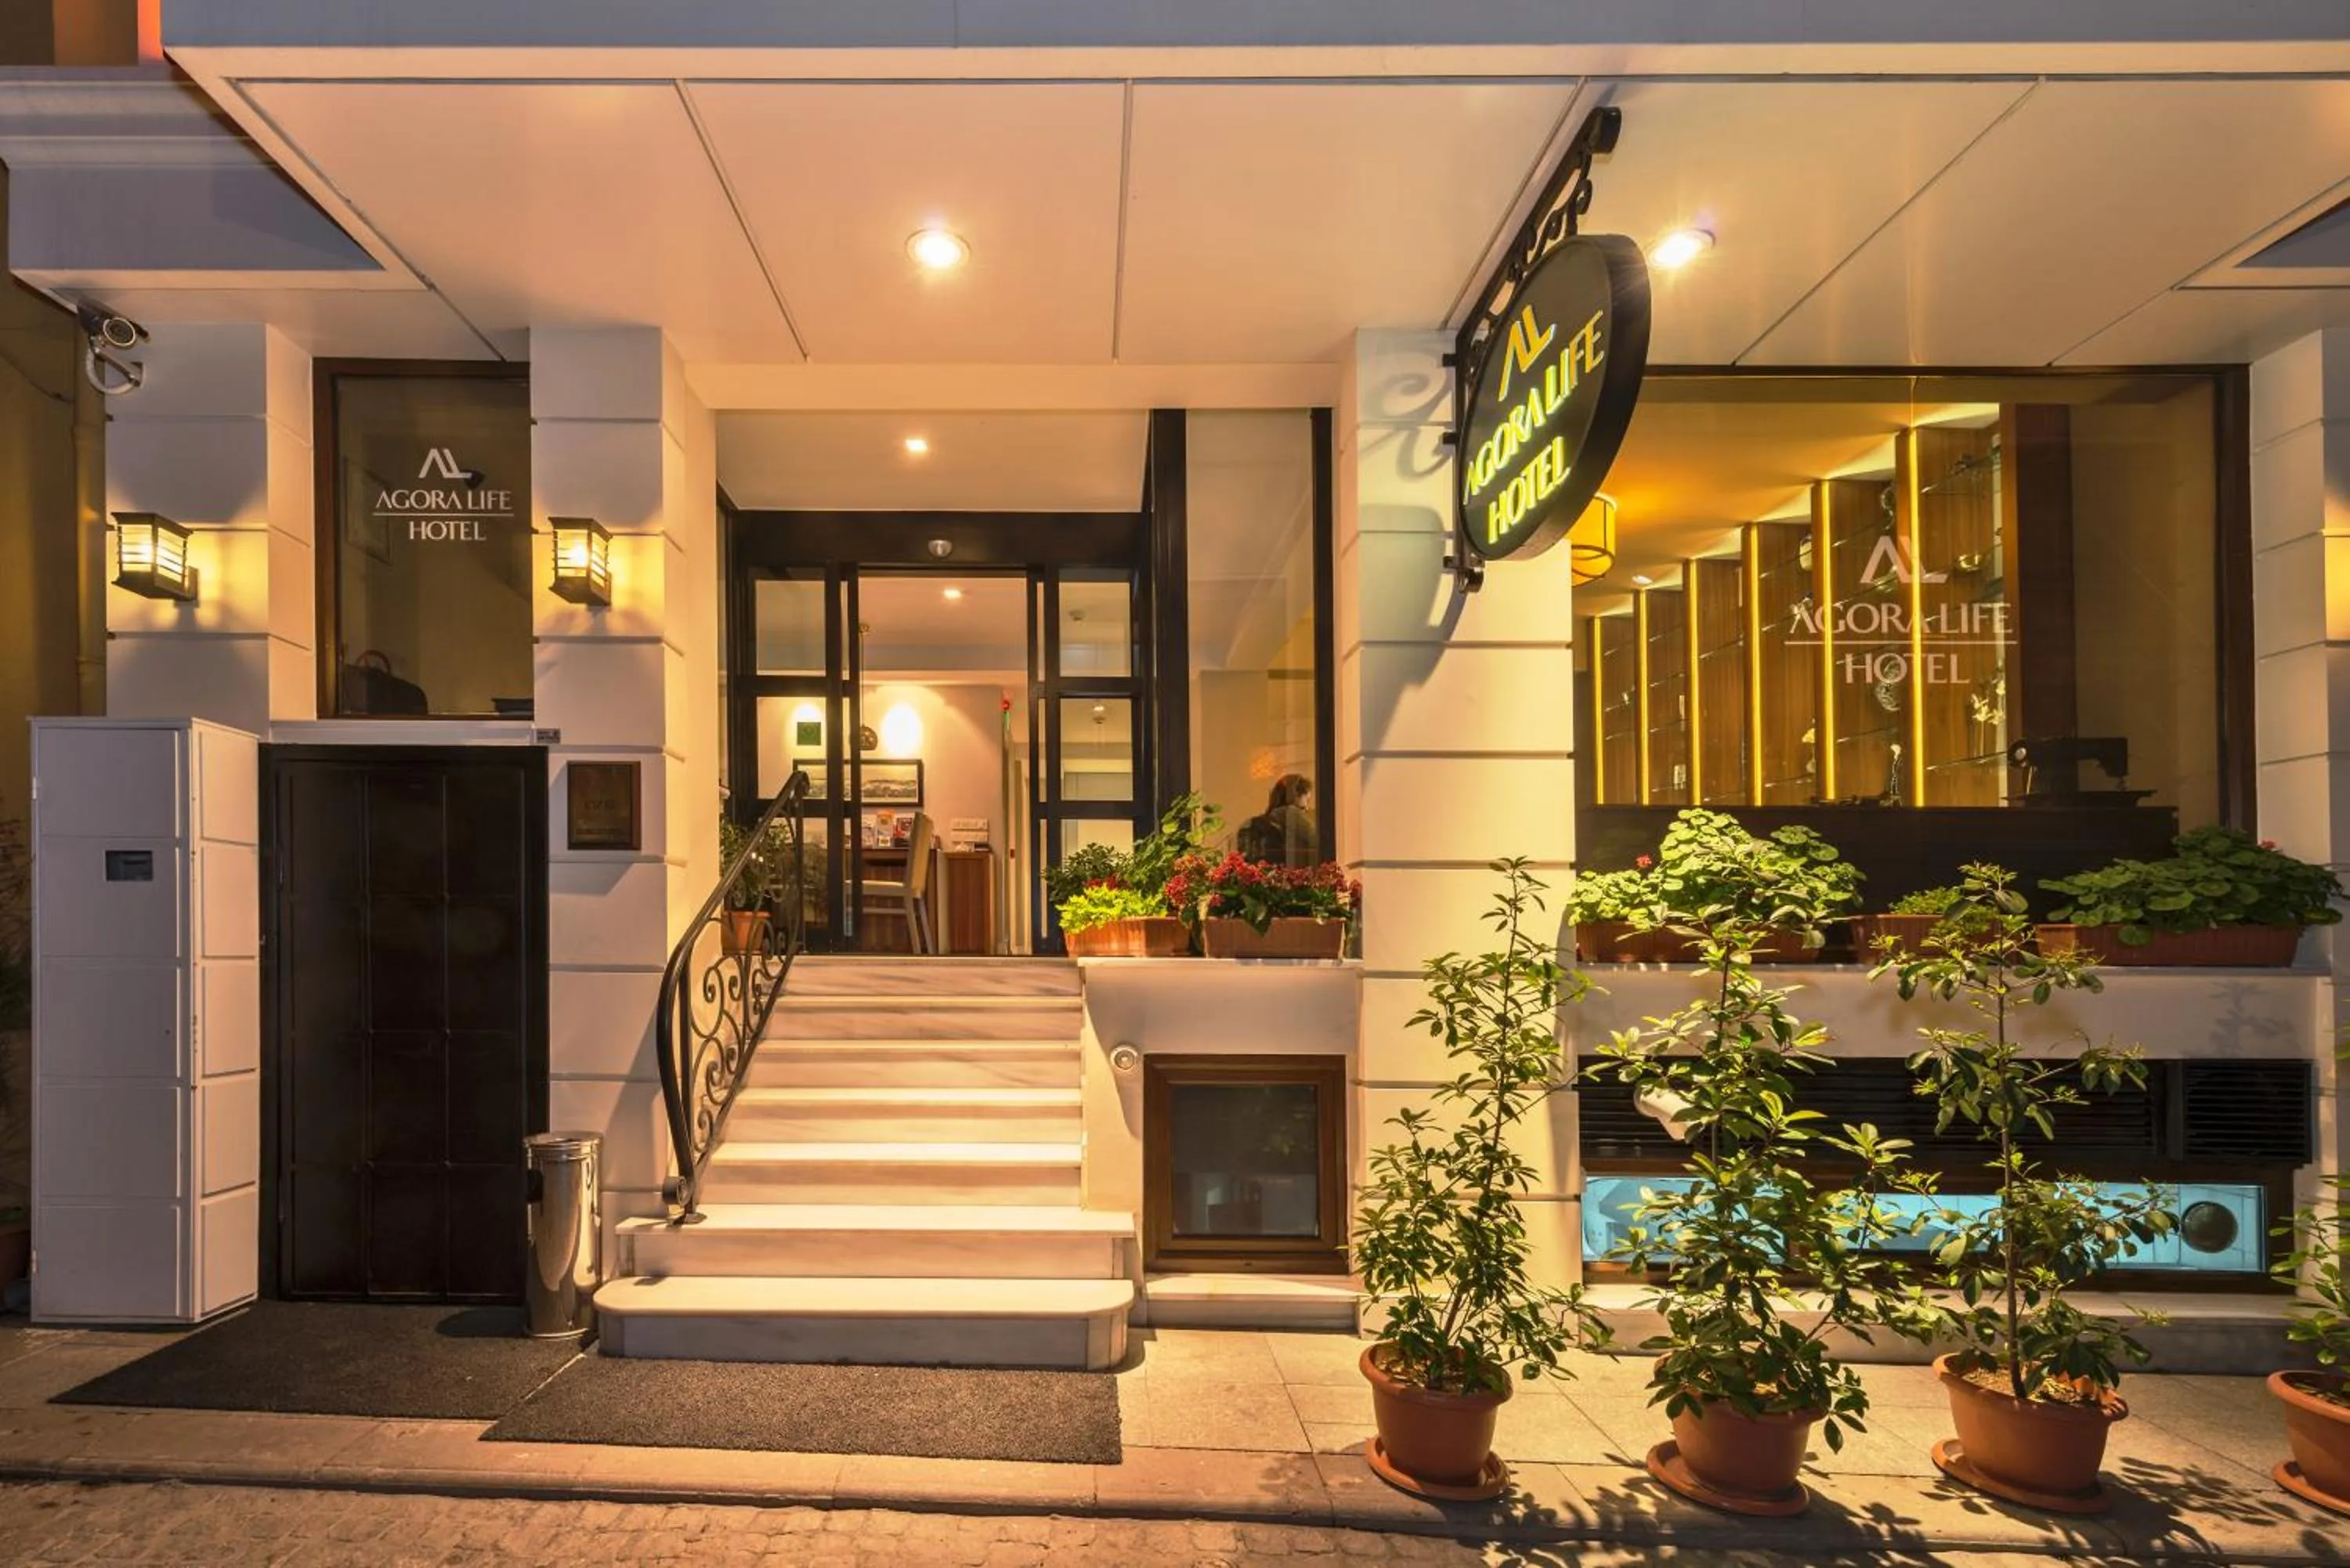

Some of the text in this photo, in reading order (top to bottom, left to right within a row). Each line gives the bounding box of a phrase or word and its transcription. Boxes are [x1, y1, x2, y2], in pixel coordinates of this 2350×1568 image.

[1462, 309, 1604, 504] AGORA LIFE
[376, 490, 512, 510] AGORA LIFE
[1488, 435, 1571, 544] HOTEL
[409, 520, 486, 541] HOTEL
[1788, 602, 2013, 634] AGORA LIFE
[1845, 653, 1970, 684] HOTEL
